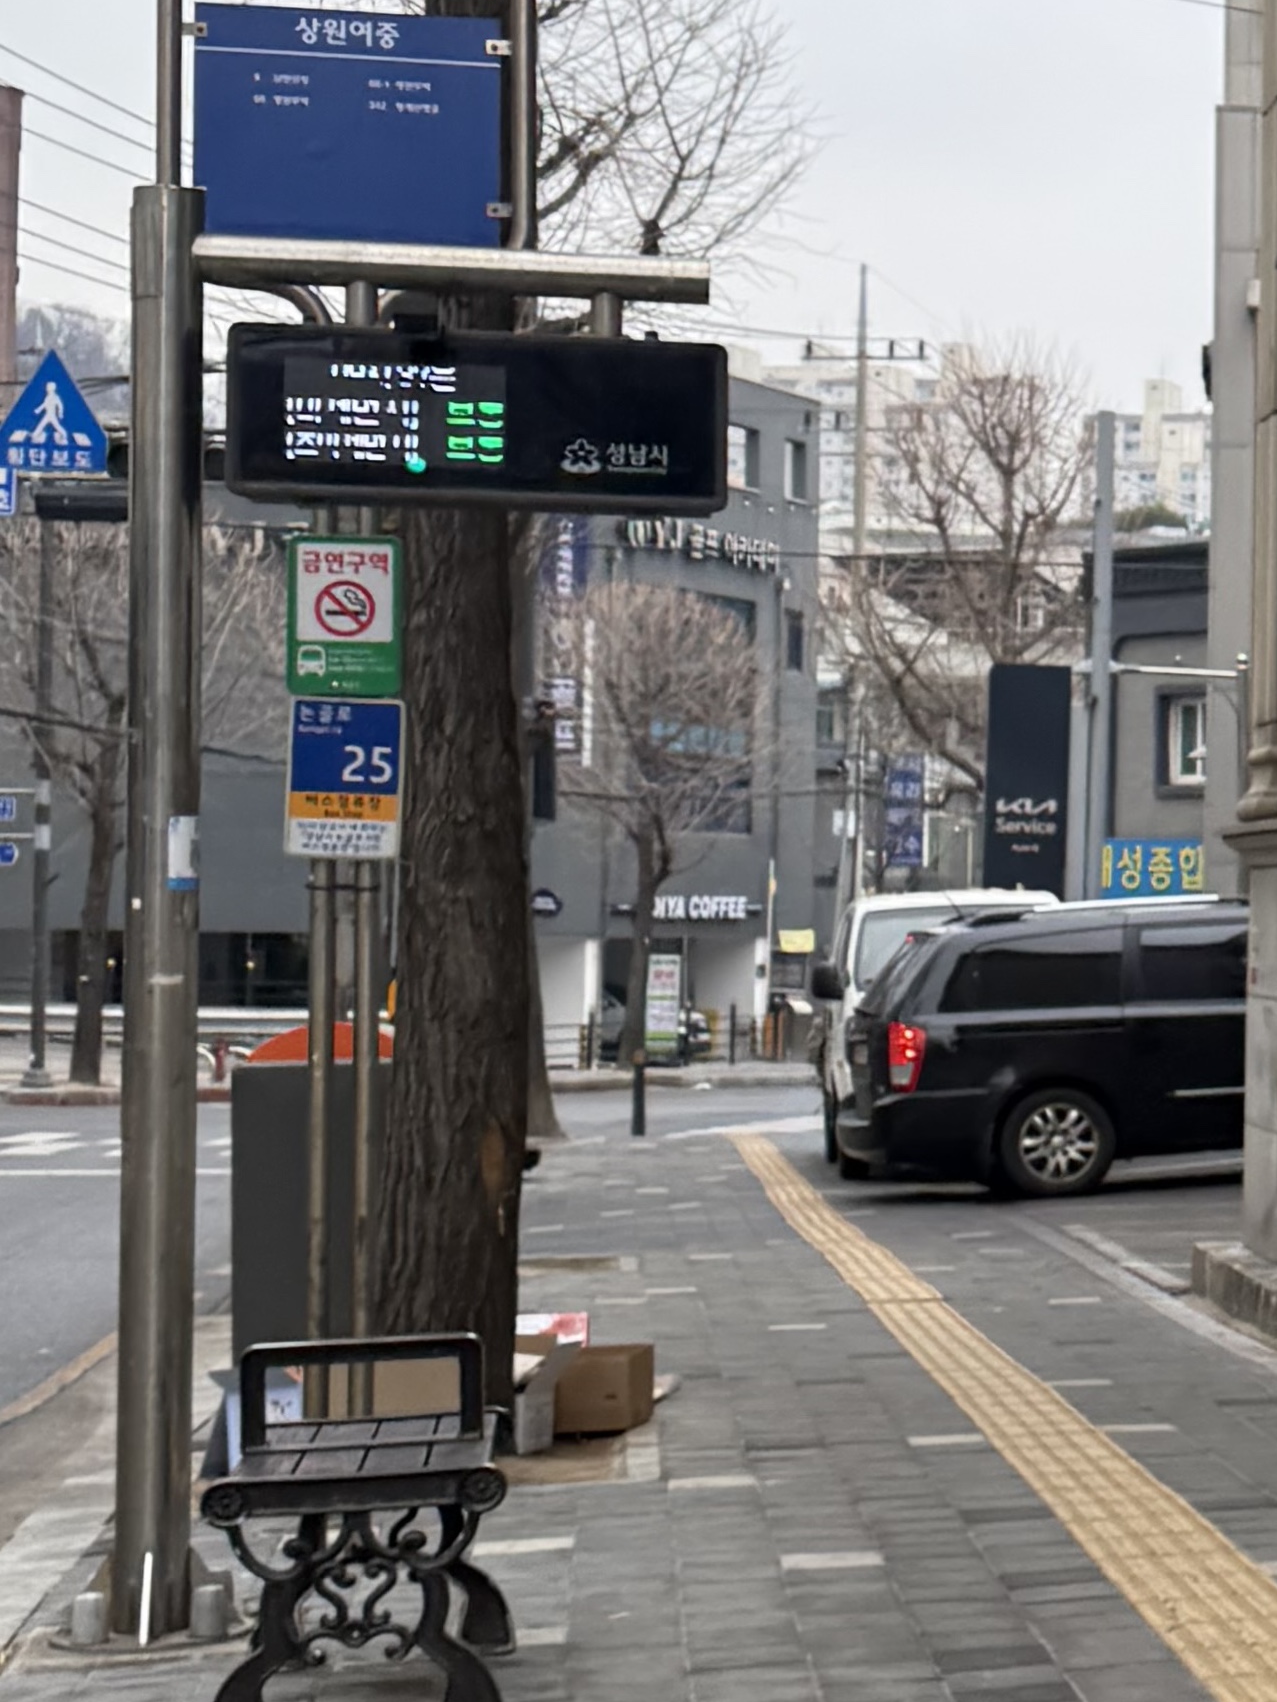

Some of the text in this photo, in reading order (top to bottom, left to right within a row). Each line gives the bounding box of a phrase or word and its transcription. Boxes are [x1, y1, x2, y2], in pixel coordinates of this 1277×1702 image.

[294, 16, 400, 49] 상원여중
[606, 442, 669, 467] 성남시
[301, 550, 390, 577] 금연구역
[341, 744, 393, 784] 25
[994, 817, 1058, 836] Service
[688, 895, 748, 920] COFFEE
